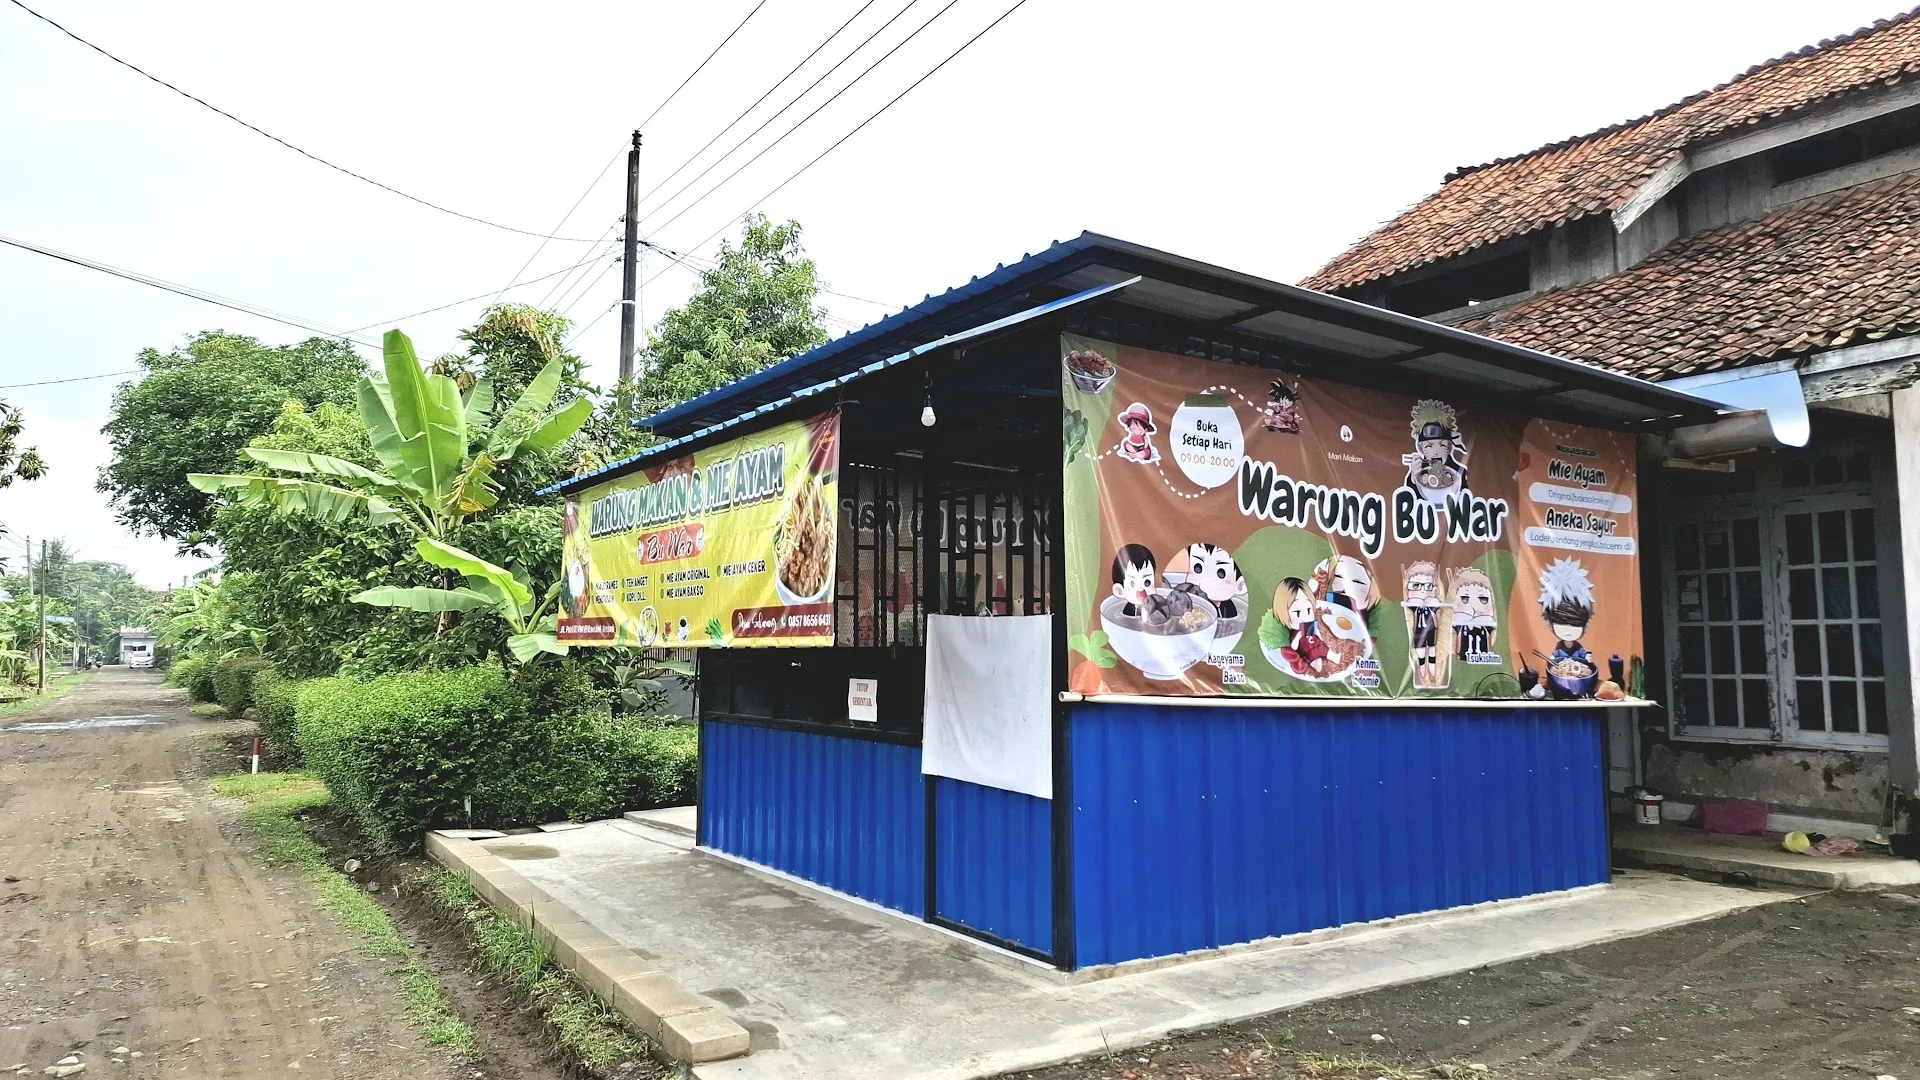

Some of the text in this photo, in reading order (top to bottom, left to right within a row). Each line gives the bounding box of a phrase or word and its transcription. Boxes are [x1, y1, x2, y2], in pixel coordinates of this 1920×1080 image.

[1196, 419, 1219, 434] Buka
[1182, 433, 1232, 451] Setiap Hari
[1328, 451, 1363, 463] Mari Makan
[1549, 459, 1606, 488] Mie Ayam
[590, 444, 786, 537] WARUNG MAKAN & MIE AYAM
[1240, 459, 1507, 557] Warung Bu War
[1546, 508, 1617, 538] Aneka Sayur
[646, 528, 693, 561] Bu War
[666, 568, 710, 583] MIE AYAM ORIGINAL
[723, 560, 766, 576] MIE AYAM CEKER
[666, 585, 704, 598] MIE AYAM BAKSO
[788, 615, 802, 627] 0857
[803, 614, 818, 627] 8656
[1207, 652, 1244, 666] Kageyama
[1355, 656, 1380, 669] Kenma
[1467, 652, 1502, 663] Tsukishima
[1223, 670, 1245, 683] Bakso
